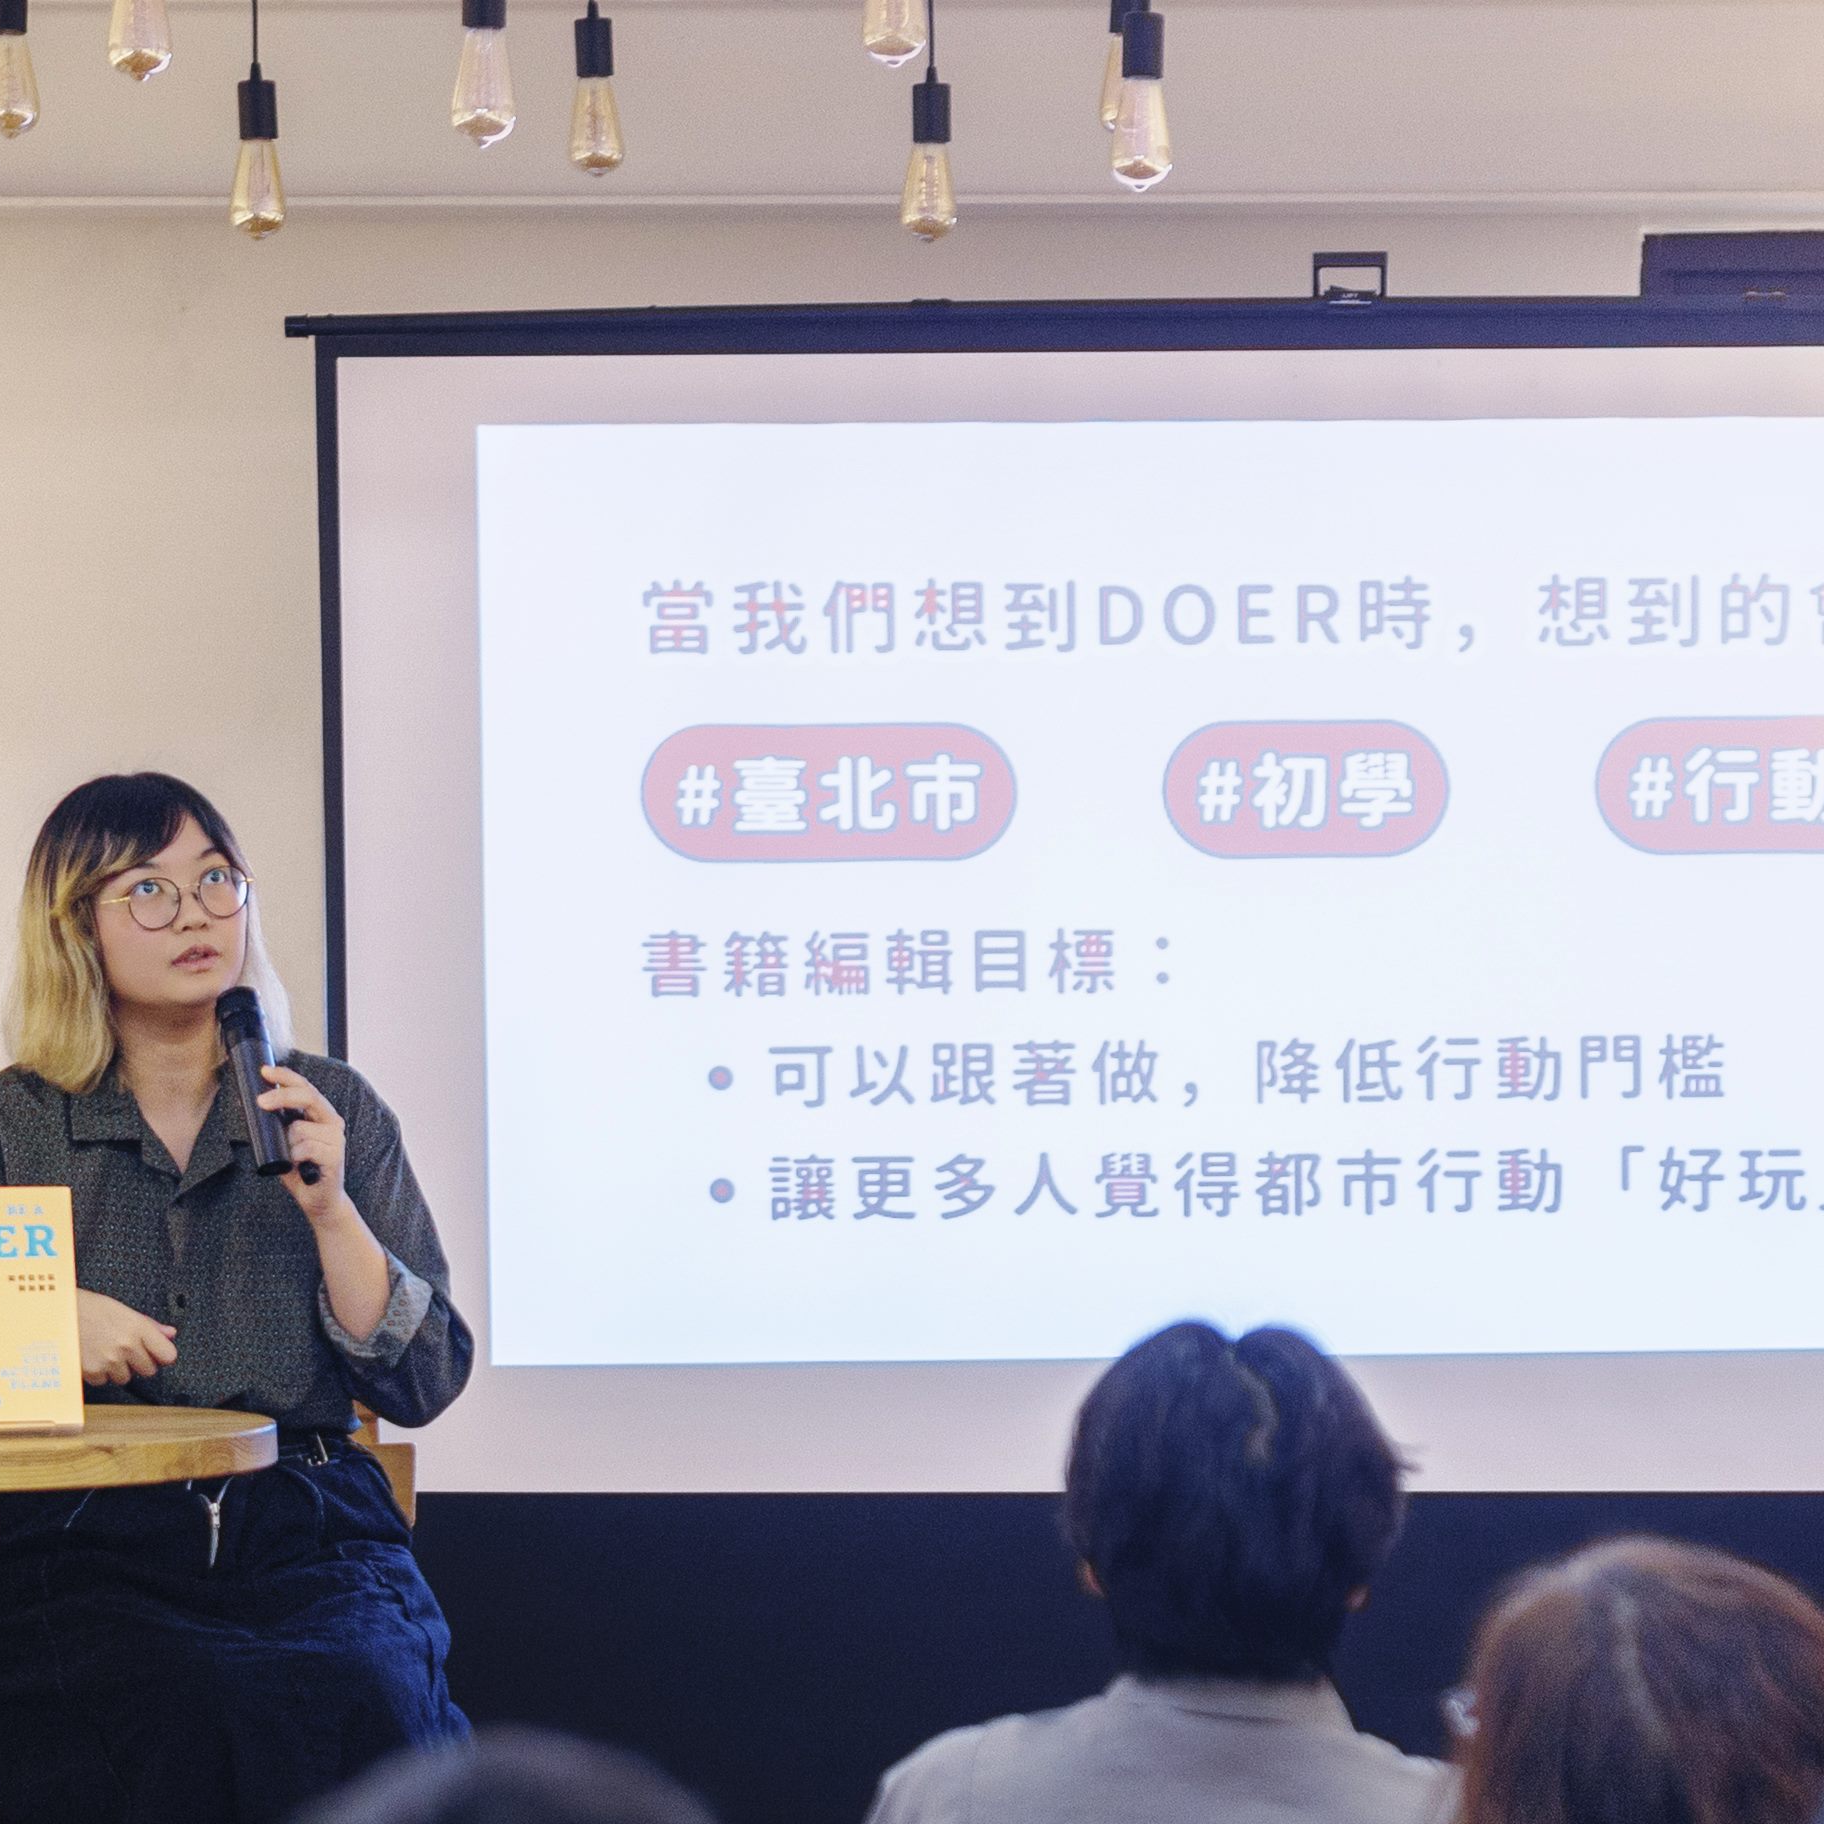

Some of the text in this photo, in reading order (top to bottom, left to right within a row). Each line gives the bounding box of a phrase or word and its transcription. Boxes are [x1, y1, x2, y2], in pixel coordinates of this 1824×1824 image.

[677, 753, 980, 832] #臺北市
[1197, 751, 1414, 829] #初學
[641, 927, 1172, 998] 書籍編輯目標：
[768, 1033, 1726, 1110] 可以跟著做，降低行動門檻
